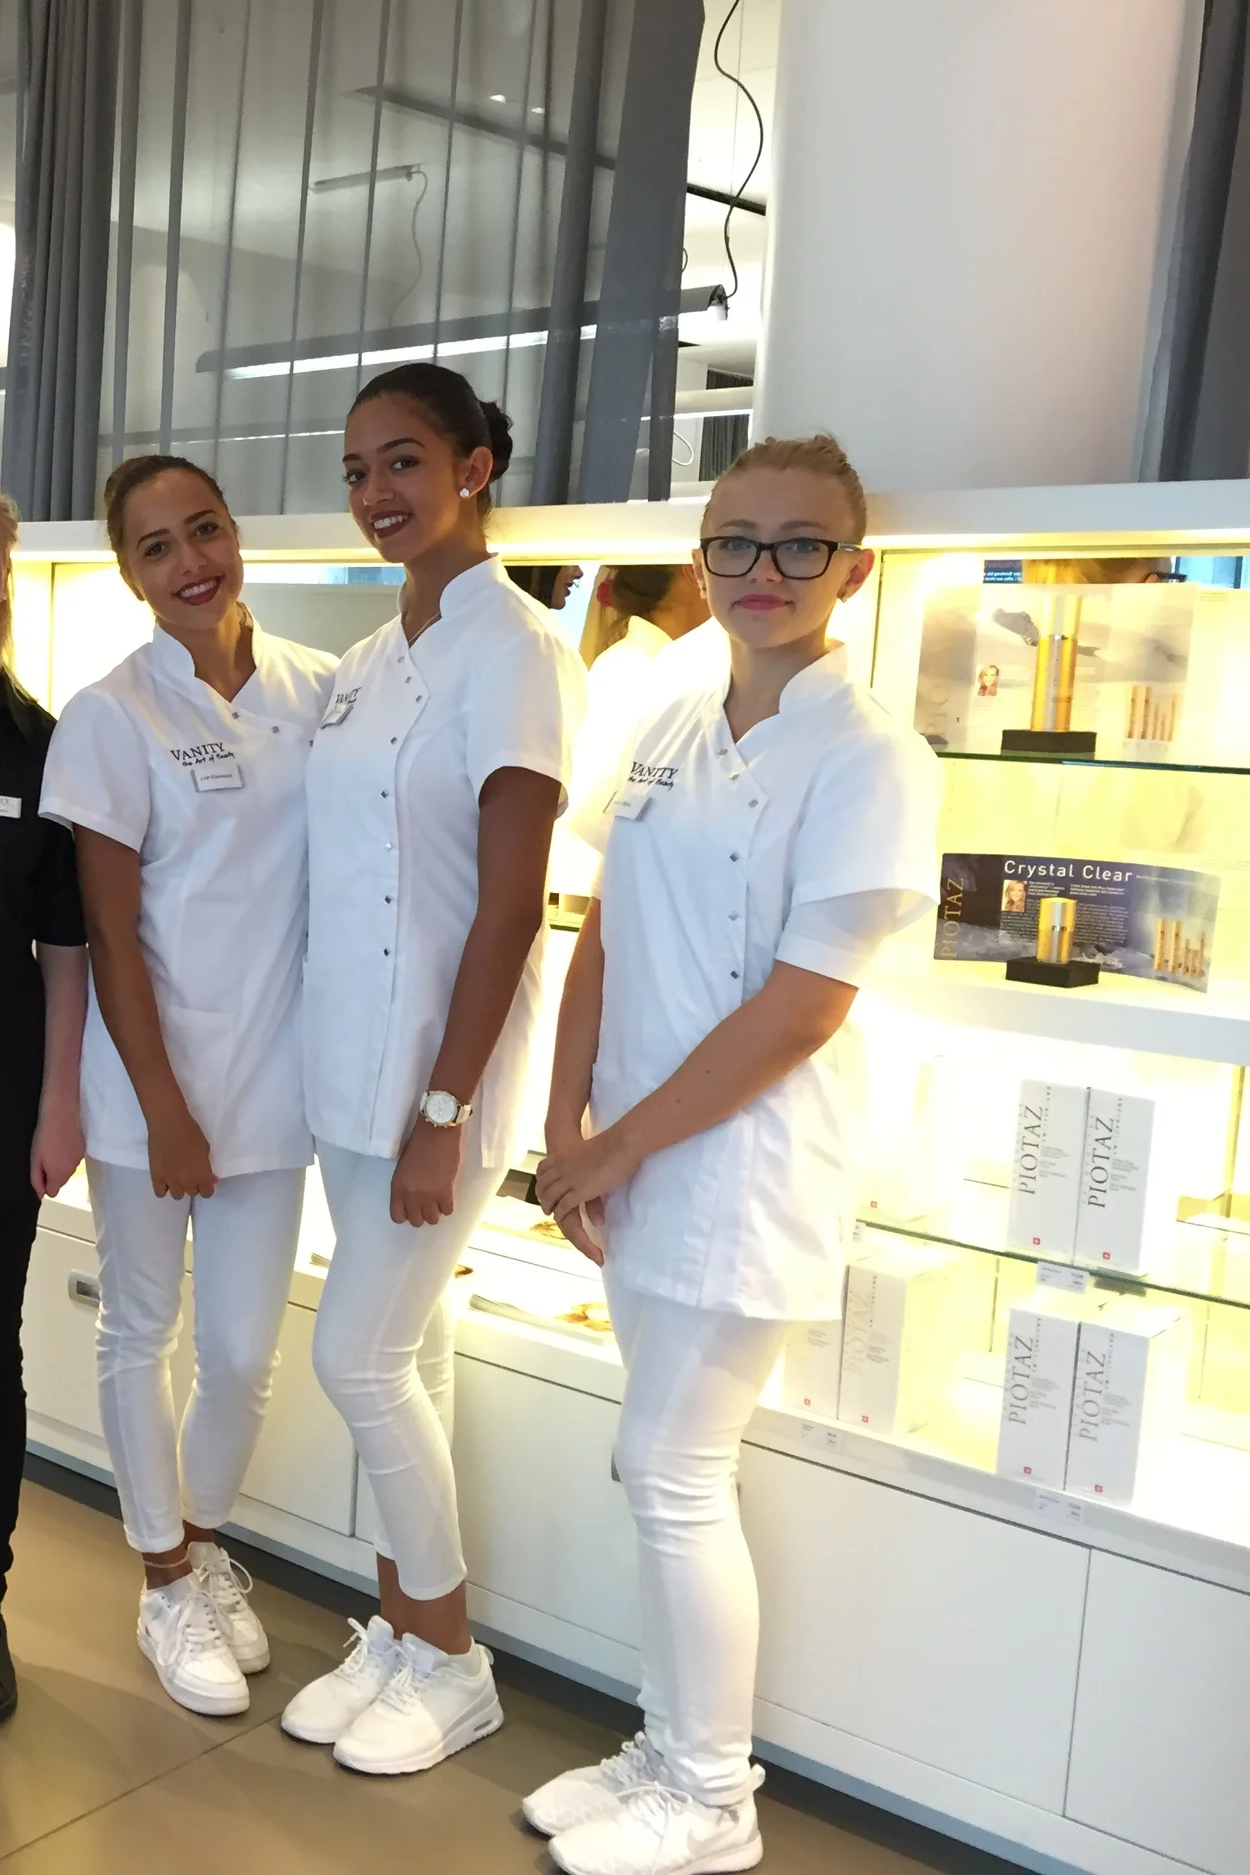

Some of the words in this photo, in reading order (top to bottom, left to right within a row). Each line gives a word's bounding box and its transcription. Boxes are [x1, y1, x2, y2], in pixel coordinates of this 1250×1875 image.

[170, 742, 225, 761] VANITY
[630, 761, 679, 779] VANITY
[1004, 860, 1075, 879] Crystal
[1082, 865, 1134, 882] Clear
[941, 877, 964, 957] PIOTAZ
[1018, 1105, 1043, 1194] PIOTAZ
[1088, 1117, 1114, 1208] PIOTAZ
[1008, 1336, 1034, 1425] PIOTAZ
[1079, 1351, 1106, 1442] PIOTAZ
